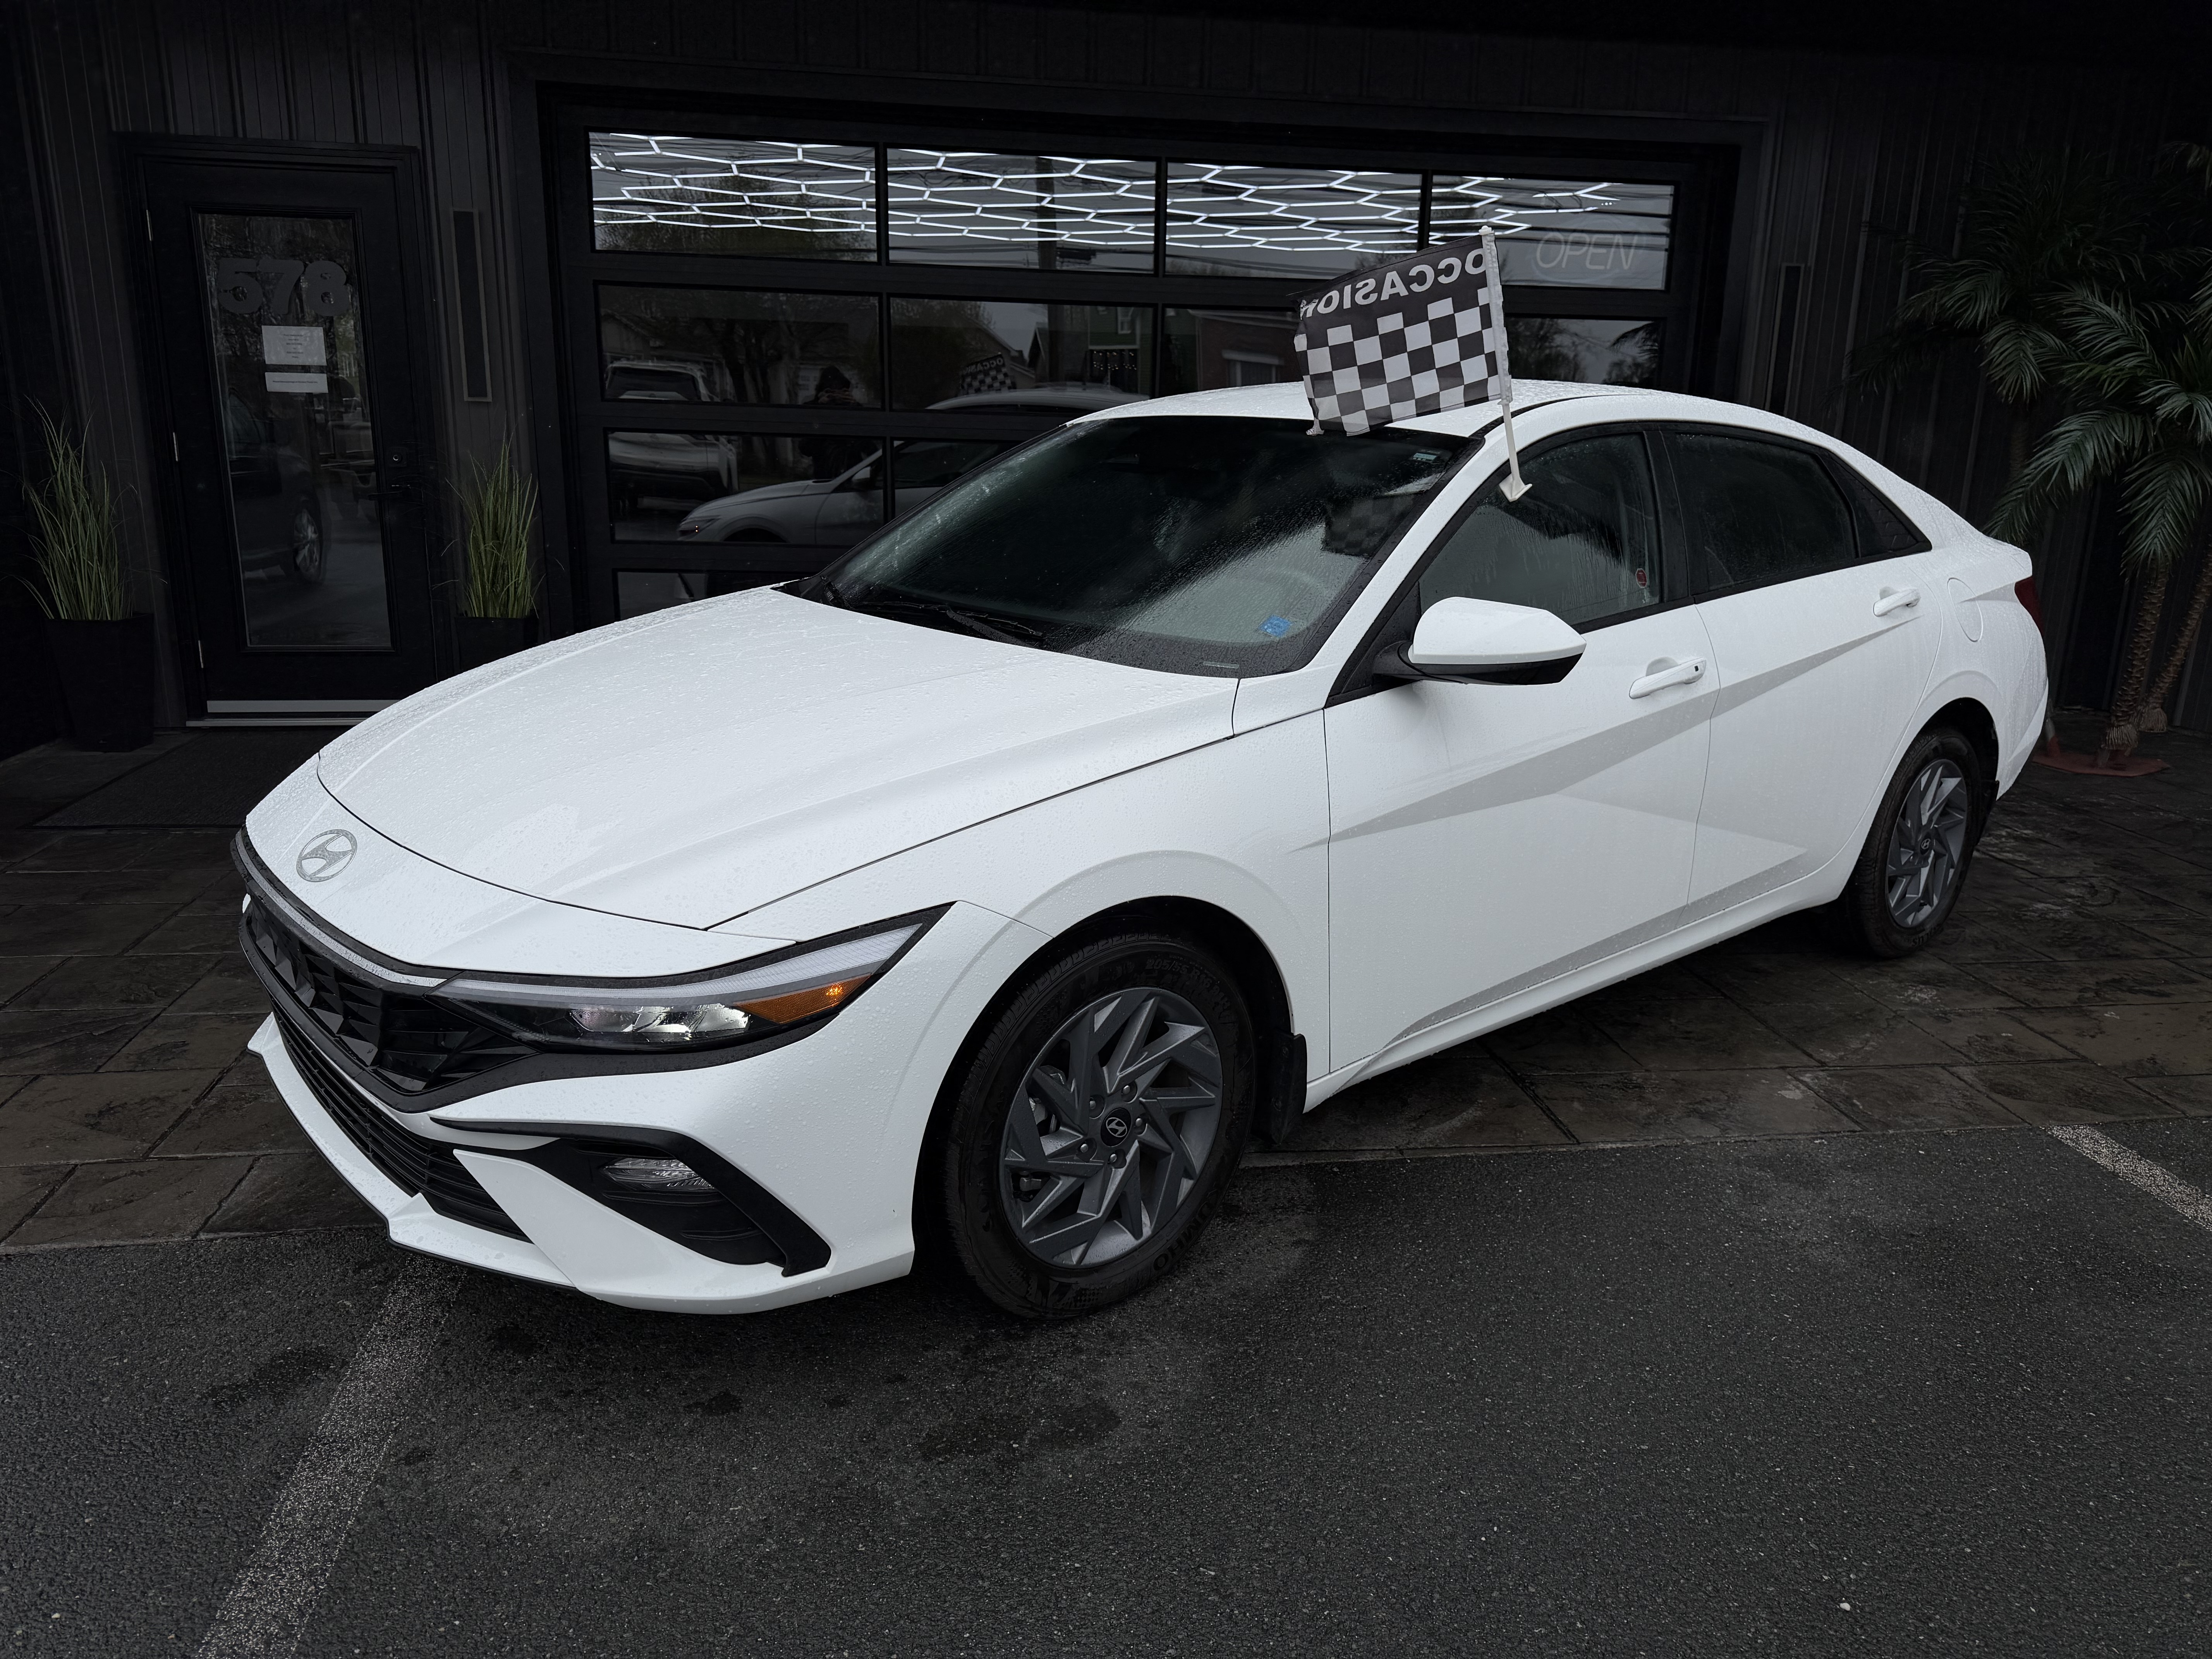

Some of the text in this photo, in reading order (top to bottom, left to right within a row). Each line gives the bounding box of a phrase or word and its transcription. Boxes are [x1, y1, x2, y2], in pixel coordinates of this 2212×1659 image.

[1535, 233, 1638, 270] OPEN
[218, 257, 352, 316] 578
[1145, 959, 1189, 974] 205/55
[1189, 966, 1212, 989] R16
